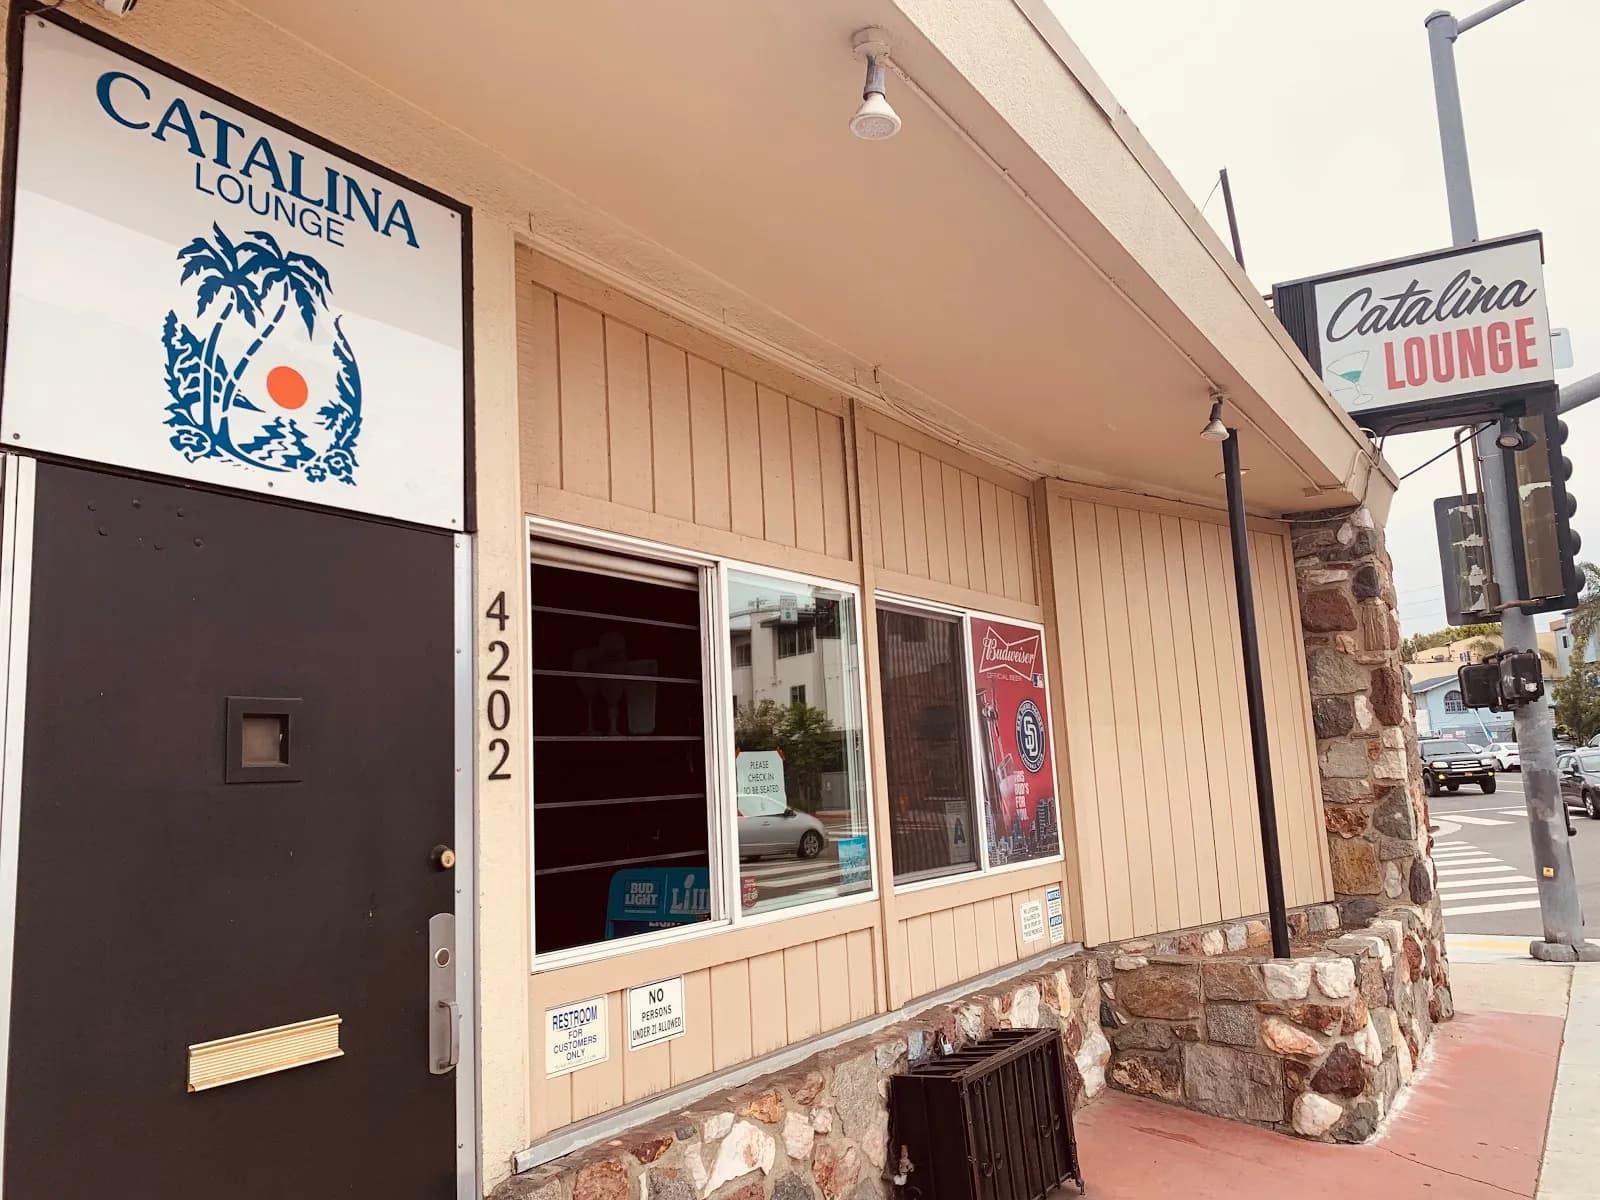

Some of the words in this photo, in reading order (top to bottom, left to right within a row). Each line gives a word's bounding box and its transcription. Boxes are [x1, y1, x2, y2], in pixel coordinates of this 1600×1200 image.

[96, 71, 420, 249] CATALINA
[195, 163, 345, 247] LOUNGE
[1326, 269, 1537, 342] Catalina
[1384, 317, 1538, 390] LOUNGE
[983, 637, 1035, 664] Budweiser
[486, 591, 511, 780] 4202
[750, 760, 769, 770] PLEASE
[748, 773, 767, 782] CHECK
[768, 772, 775, 781] IN
[744, 786, 751, 795] TO
[752, 786, 759, 795] BE
[760, 784, 779, 794] SEATED
[1014, 782, 1030, 795] BUD'S
[1015, 795, 1026, 809] FOR
[953, 816, 966, 845] A
[630, 882, 654, 894] BUD
[624, 893, 658, 905] LIGHT
[648, 987, 664, 1005] NO
[552, 1005, 598, 1031] RESTROOM
[641, 1004, 672, 1022] PERSONS
[568, 1028, 583, 1040] FOR
[632, 1025, 651, 1041] UNDER
[651, 1023, 657, 1036] 21
[658, 1016, 682, 1033] ALLOWED
[553, 1035, 598, 1054] CUSTOMERS
[566, 1048, 586, 1061] ONLY
